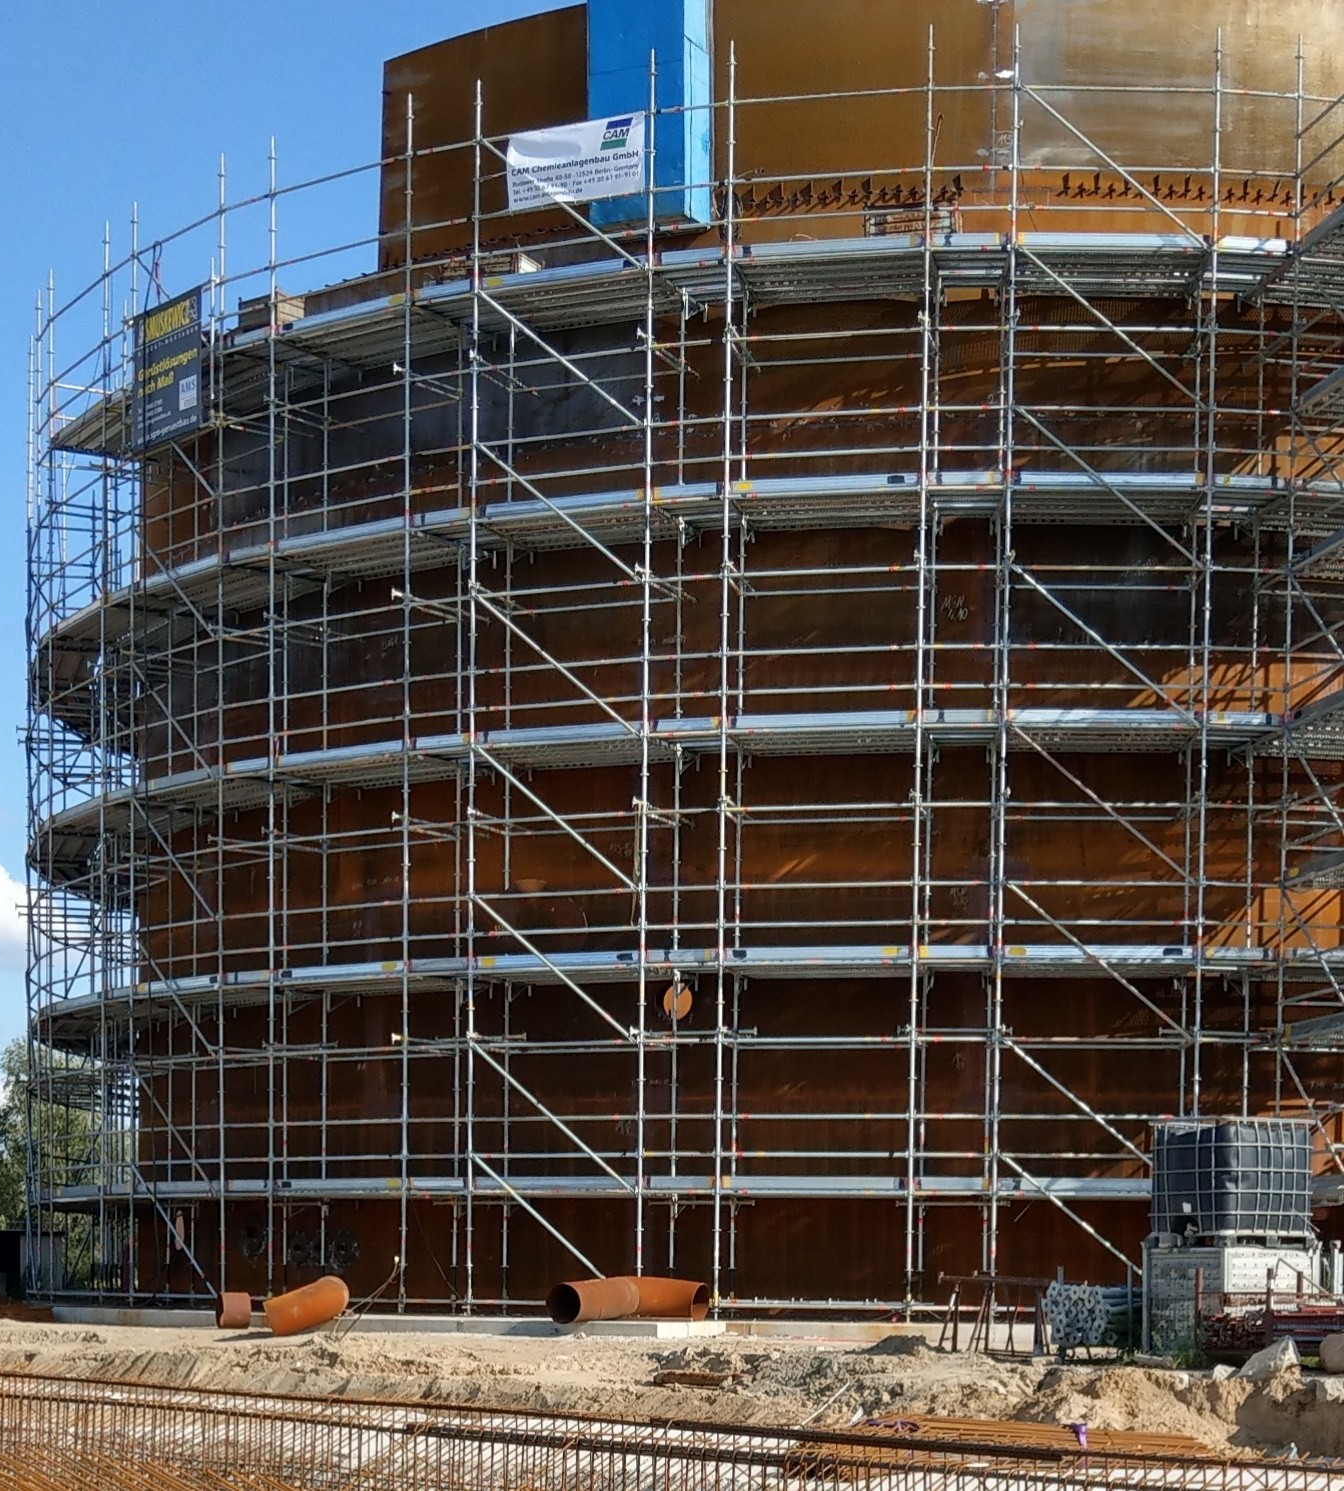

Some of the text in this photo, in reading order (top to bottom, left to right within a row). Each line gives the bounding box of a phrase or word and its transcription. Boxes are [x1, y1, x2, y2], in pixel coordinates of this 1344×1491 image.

[603, 128, 630, 140] CAM
[511, 150, 639, 176] CAM Chemieanlagenbau GmbH
